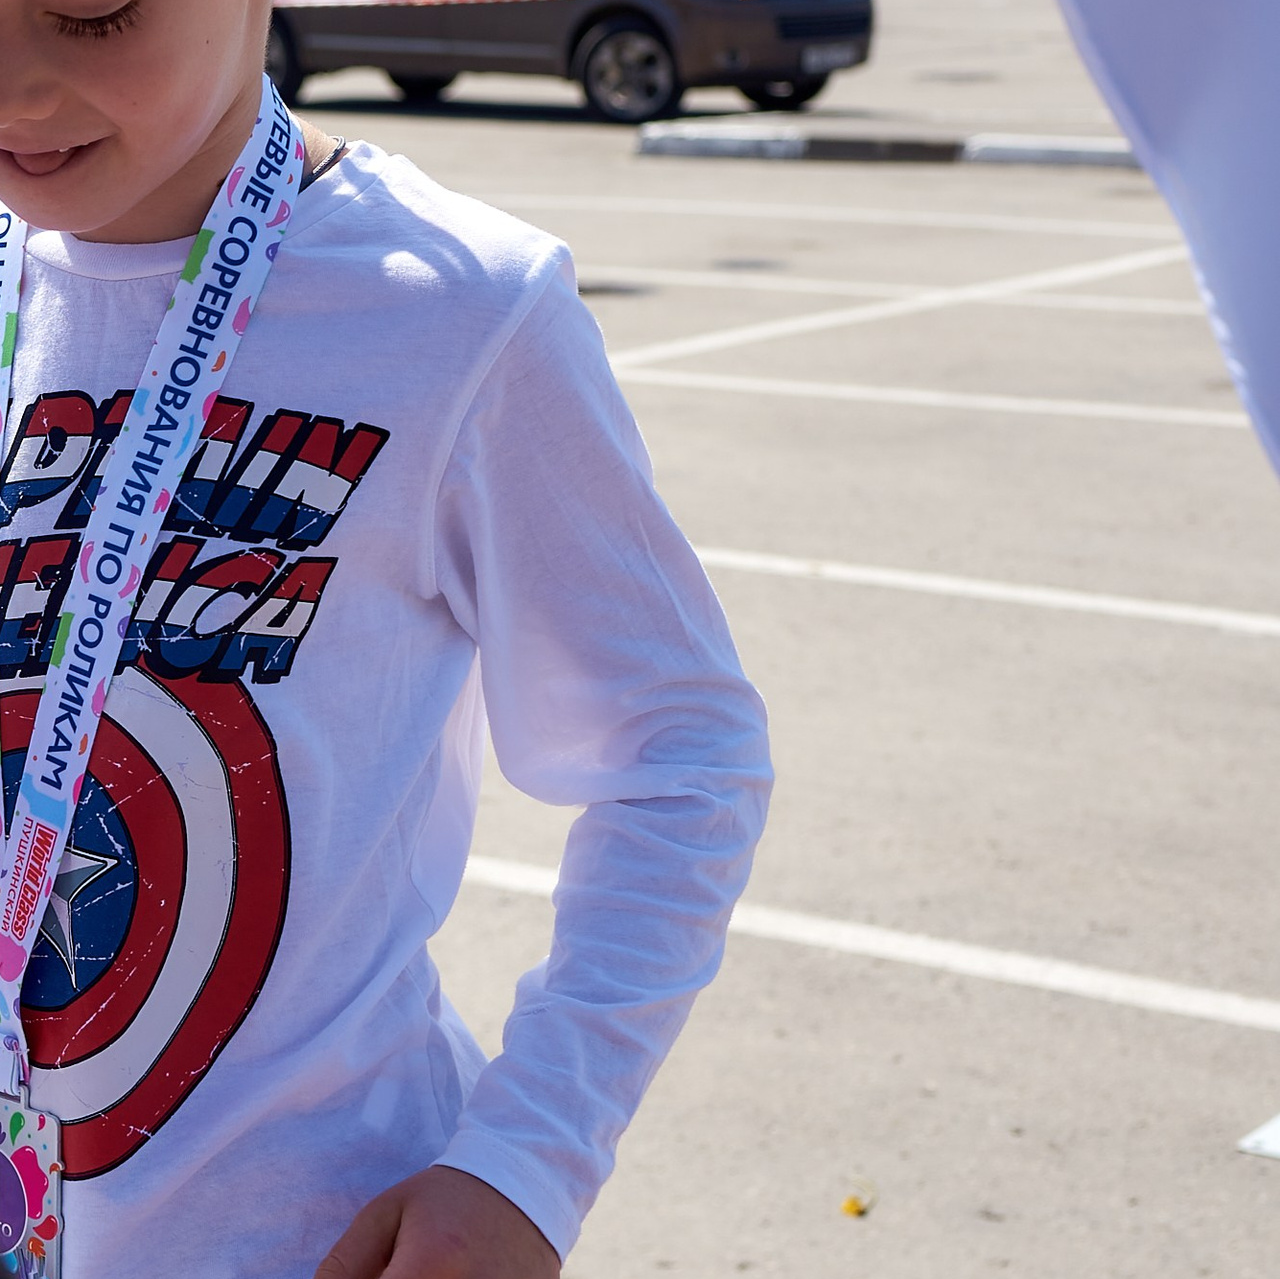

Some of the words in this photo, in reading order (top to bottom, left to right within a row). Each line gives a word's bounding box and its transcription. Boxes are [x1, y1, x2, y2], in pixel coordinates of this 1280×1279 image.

[116, 216, 257, 512] СОРЕВНОВАНИЯ
[94, 522, 131, 586] ПО
[40, 594, 106, 791] РОЛИКАМ
[1, 816, 34, 932] ПУШКИНСКИЙ
[24, 824, 54, 888] World
[13, 882, 38, 939] Class
